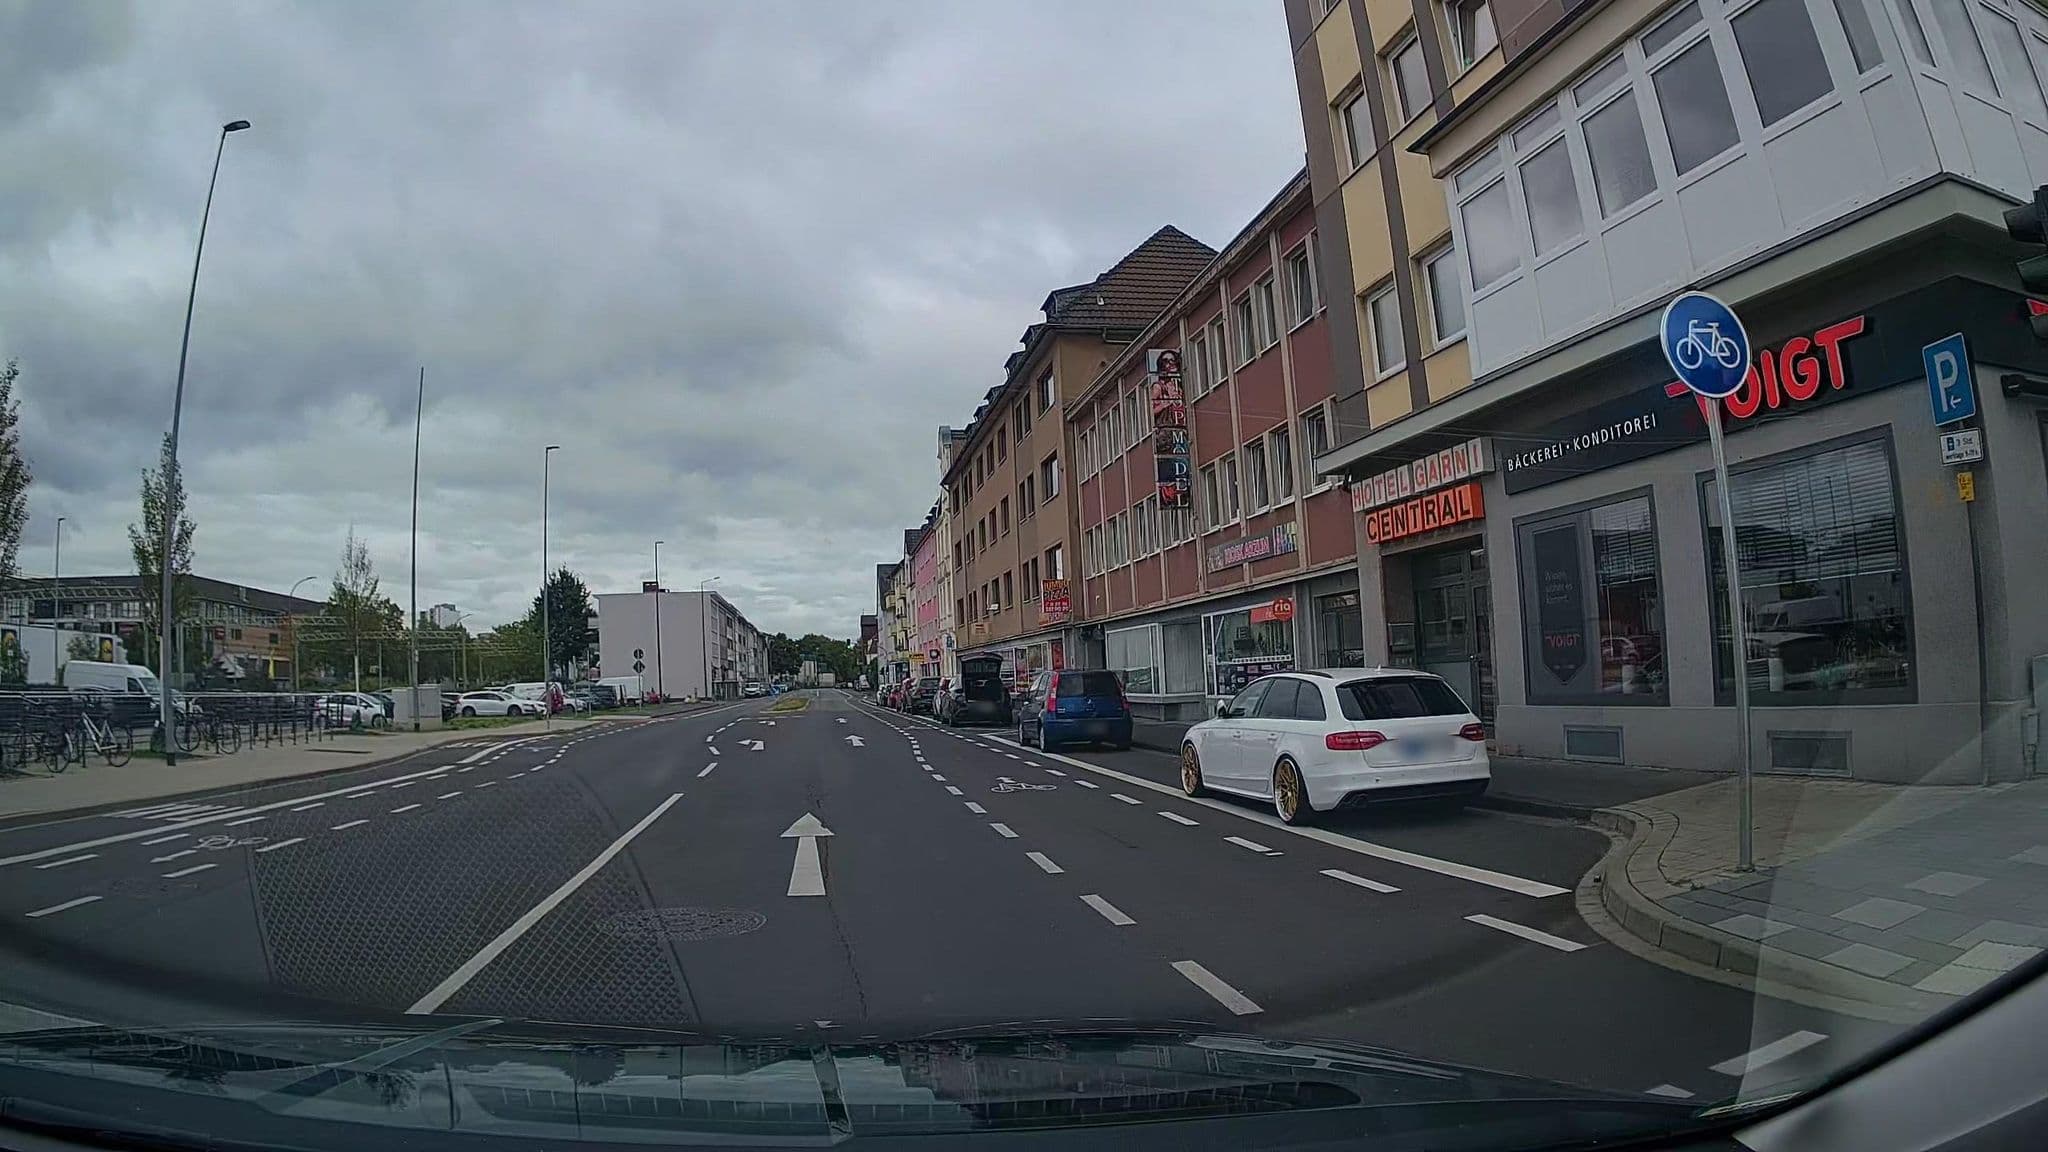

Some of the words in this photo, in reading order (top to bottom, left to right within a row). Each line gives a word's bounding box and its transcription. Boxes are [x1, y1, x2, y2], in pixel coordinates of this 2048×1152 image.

[1934, 350, 1959, 413] P
[1573, 413, 1657, 452] KONDITOREI
[1352, 467, 1409, 511] HOTEL
[1414, 444, 1479, 487] GARNI
[1367, 488, 1471, 541] CENTRAL
[1043, 586, 1069, 600] PIZZA
[1274, 599, 1291, 612] ria
[1545, 633, 1581, 648] VOIGT
